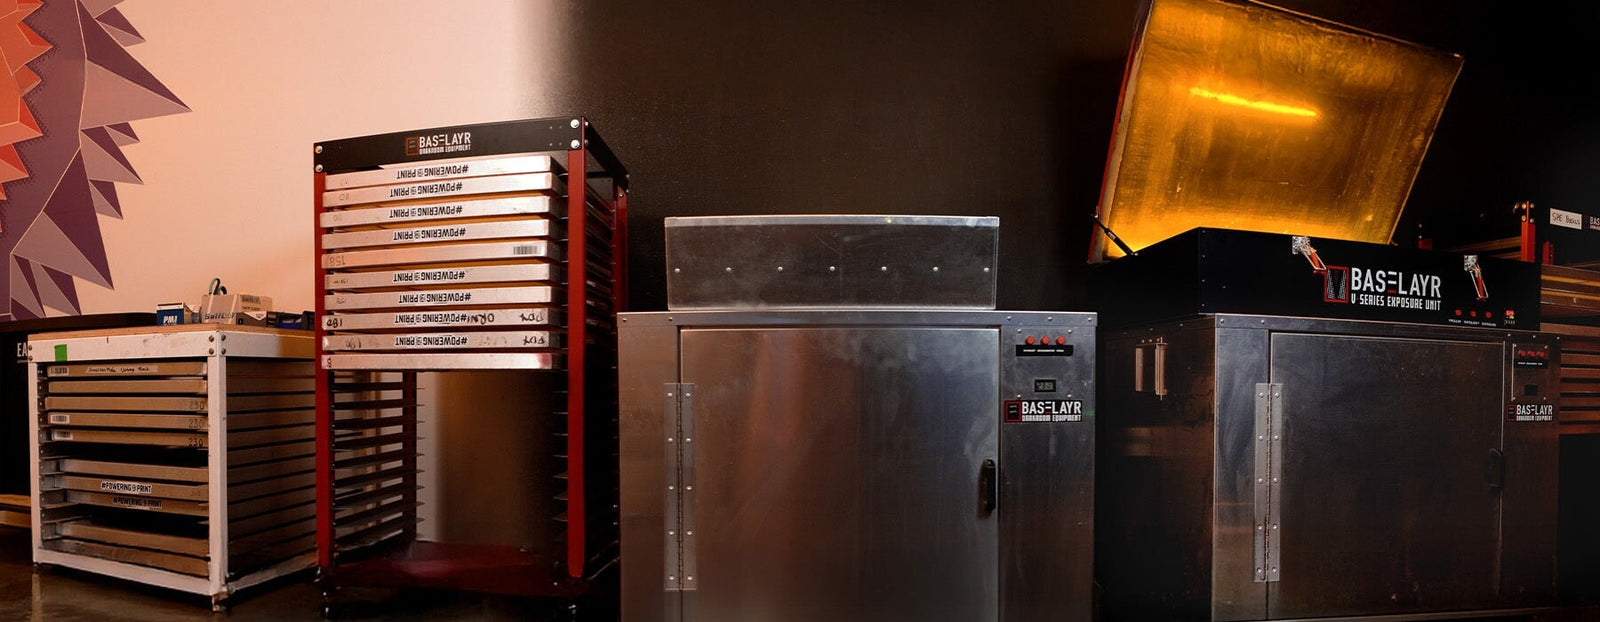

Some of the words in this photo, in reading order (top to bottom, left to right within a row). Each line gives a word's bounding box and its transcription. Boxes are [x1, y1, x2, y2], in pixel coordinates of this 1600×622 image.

[419, 132, 471, 148] BASELAYR
[396, 169, 417, 180] PRINT
[424, 165, 469, 178] #POWERING
[390, 186, 410, 197] PRINT
[417, 181, 463, 195] #POWERING
[389, 208, 410, 219] PRINT
[417, 205, 463, 218] #POWERING
[393, 231, 414, 241] PRINT
[421, 227, 467, 240] #POWERING
[393, 272, 413, 283] PRINT
[420, 270, 465, 283] #POWERING
[1351, 267, 1441, 298] BASELAYR
[398, 293, 419, 304] PRINT
[426, 292, 471, 304] #POWERING
[1360, 294, 1385, 306] SERIES
[1387, 296, 1423, 309] EXPOSURE
[1425, 299, 1441, 311] UNIT
[395, 314, 415, 324] PRINT
[422, 312, 467, 324] #POWERING
[395, 336, 415, 346] PRINT
[422, 335, 468, 346] #POWERING
[1022, 401, 1082, 415] BASELAYR
[1516, 404, 1553, 415] BASELAYR
[136, 484, 152, 493] PRINT
